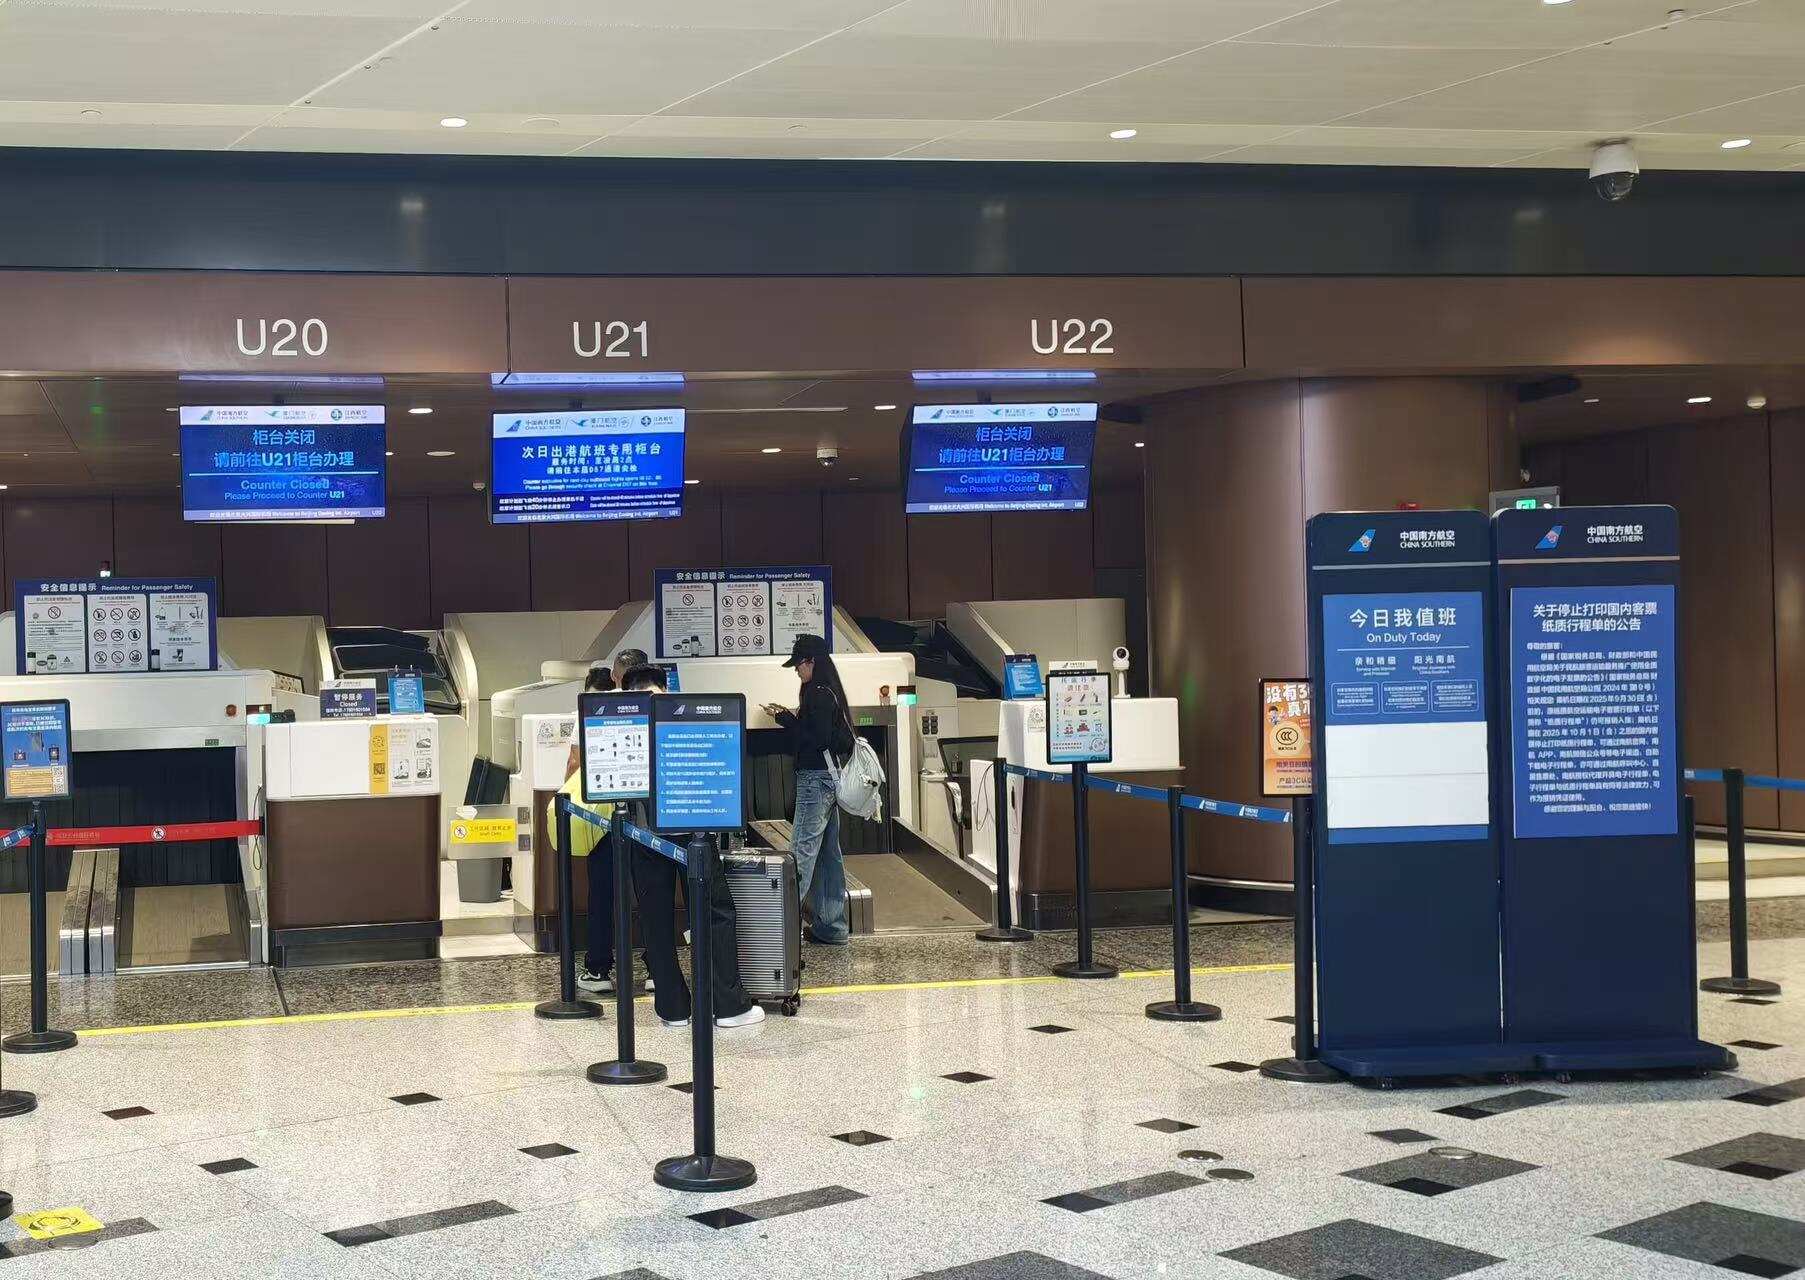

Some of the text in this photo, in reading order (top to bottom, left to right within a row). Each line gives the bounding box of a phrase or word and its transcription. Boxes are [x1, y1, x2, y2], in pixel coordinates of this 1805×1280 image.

[237, 319, 328, 355] U20
[573, 321, 648, 357] U21
[1031, 319, 1113, 354] U22
[252, 429, 315, 445] 柜台关闭
[976, 427, 1033, 442] 柜台关闭
[521, 443, 662, 459] 次日出港航班专用柜台
[939, 446, 1065, 463] 请前往U21柜台办理
[214, 451, 354, 468] 请前往U21柜台办理
[241, 478, 329, 490] Counter Closed
[960, 473, 1040, 485] Counter Closed
[224, 490, 345, 501] Please Proceed to Counter U21
[944, 485, 967, 493] Please
[969, 485, 999, 493] Proceed
[1009, 484, 1036, 492] Counter
[1038, 483, 1052, 492] U21
[1400, 530, 1455, 541] 中国南方航空
[1587, 525, 1643, 536] 中国南方航空
[1400, 540, 1455, 549] CHINA SOUTHERN
[1587, 536, 1607, 544] CHINA
[141, 584, 173, 592] Passenger
[1350, 607, 1457, 628] 今日我值班
[1533, 602, 1657, 618] 关于停止打印国内客票
[1542, 617, 1641, 633] 纸质行程单的公告
[1367, 632, 1441, 643] On Duty Today
